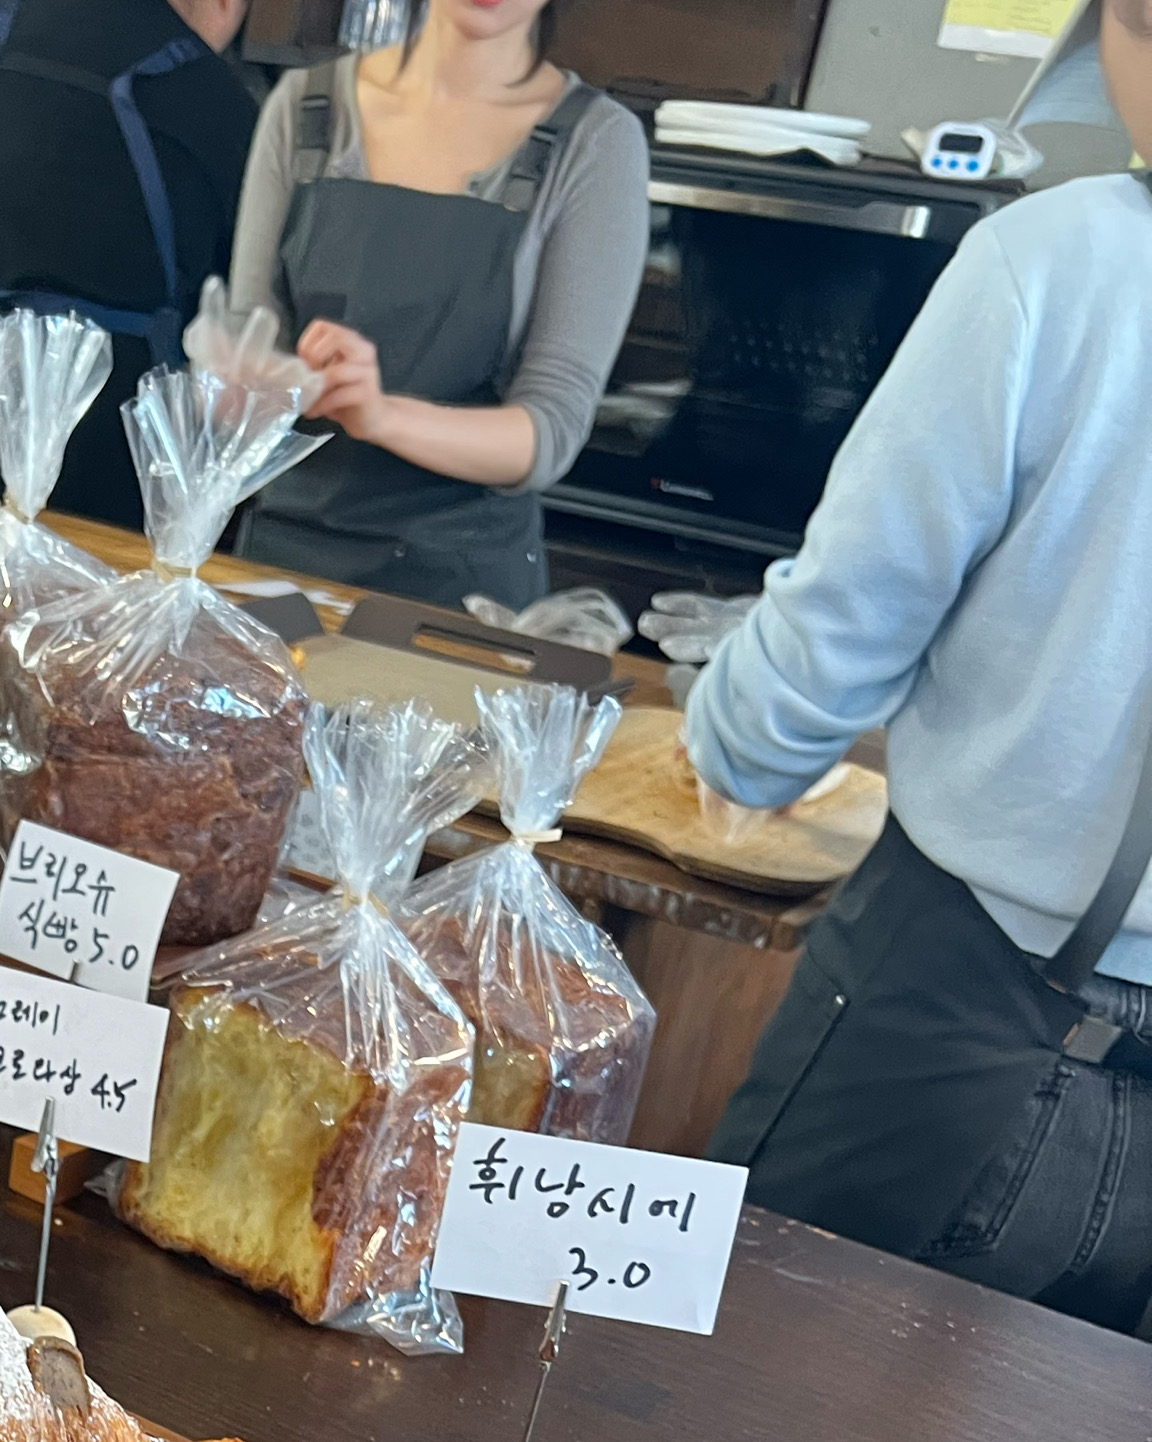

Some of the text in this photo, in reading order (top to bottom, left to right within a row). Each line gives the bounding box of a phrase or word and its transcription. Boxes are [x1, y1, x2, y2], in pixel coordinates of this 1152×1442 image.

[10, 841, 116, 917] 브리오슈
[18, 899, 139, 970] 식빵 5.0
[91, 1073, 137, 1112] 4.5
[469, 1137, 696, 1232] 휘낭시에
[569, 1247, 651, 1290] 3.0
